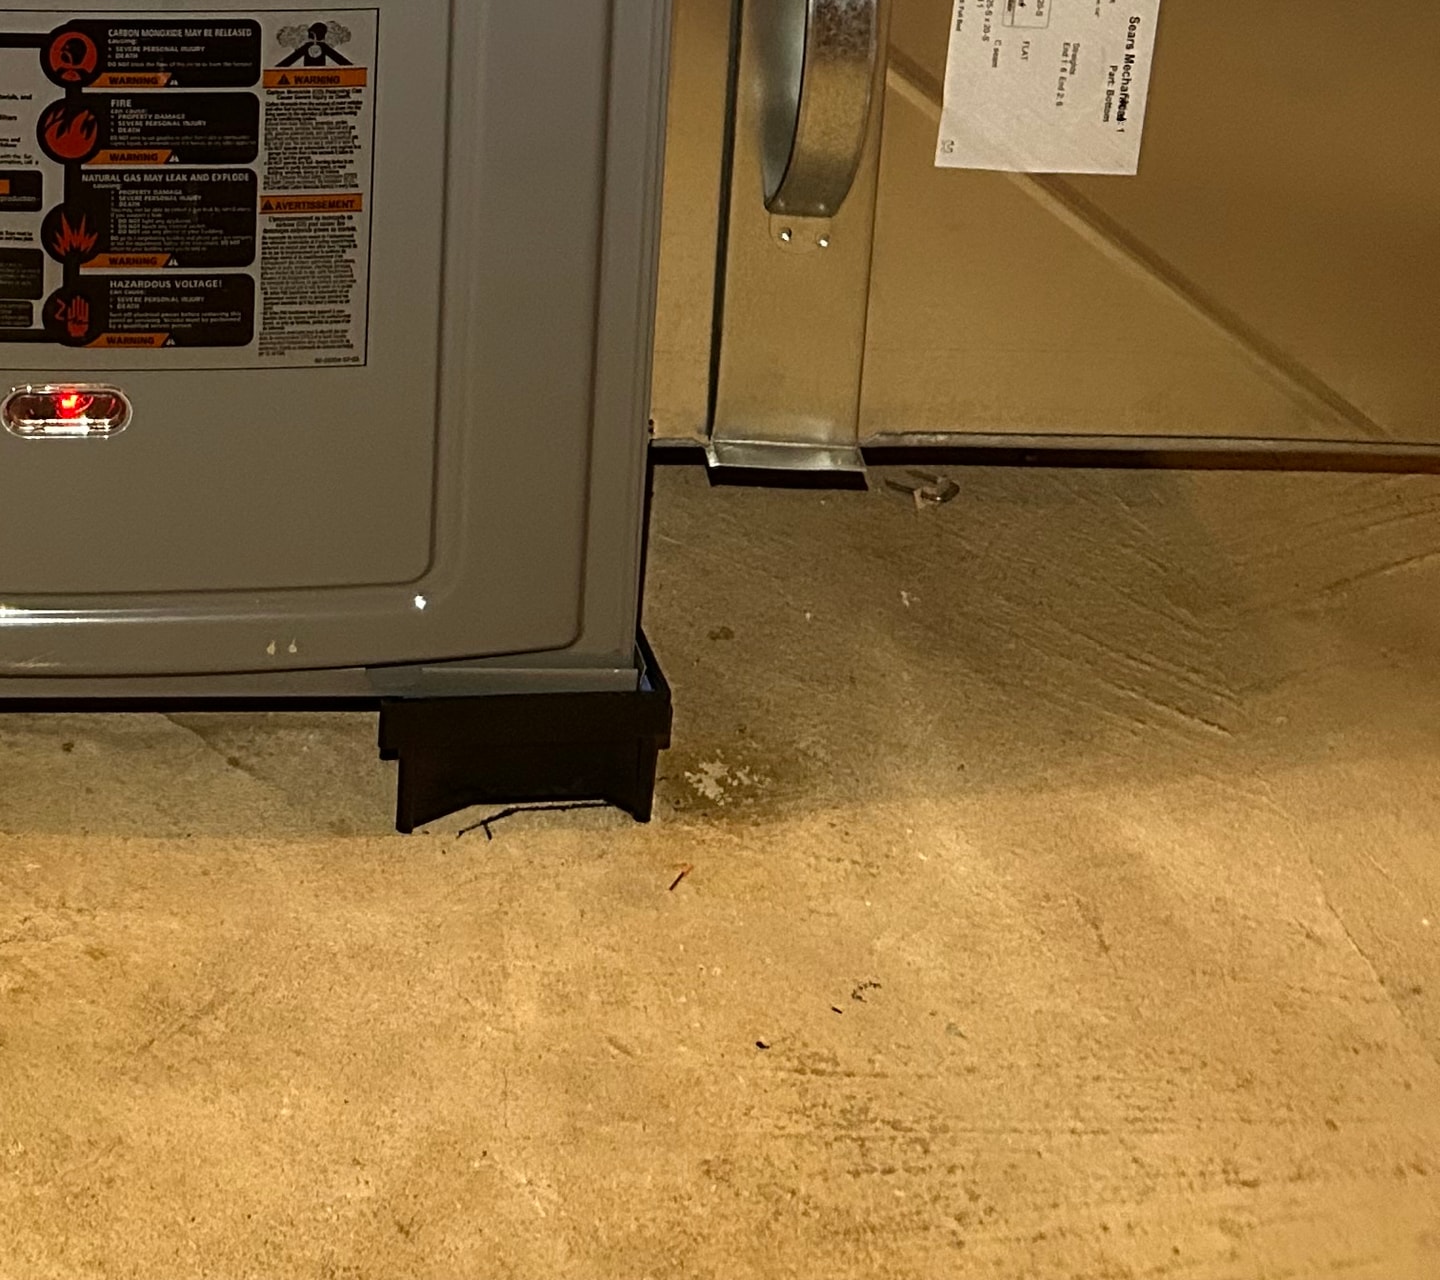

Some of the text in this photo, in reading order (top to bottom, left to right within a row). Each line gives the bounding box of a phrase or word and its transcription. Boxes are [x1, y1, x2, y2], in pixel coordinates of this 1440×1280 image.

[107, 28, 252, 38] CARBON MONOXIDE MAY RELEASED
[1125, 16, 1141, 50] Sears
[1021, 41, 1030, 61] FLAT
[1057, 42, 1070, 91] End End
[108, 76, 158, 86] WARNING
[294, 75, 341, 85] WARNING
[1102, 65, 1118, 123] Part: Bottom
[110, 99, 132, 108] FIRE
[109, 152, 158, 163] WARNING
[82, 172, 249, 183] NATURAL GAS MAY LEAK AND EXPLODE
[275, 200, 356, 211] AVERTISSEMENT
[108, 256, 158, 266] WARNING
[110, 279, 223, 289] HAZARDOUS VOLTAGE!
[106, 335, 155, 346] WARNING
